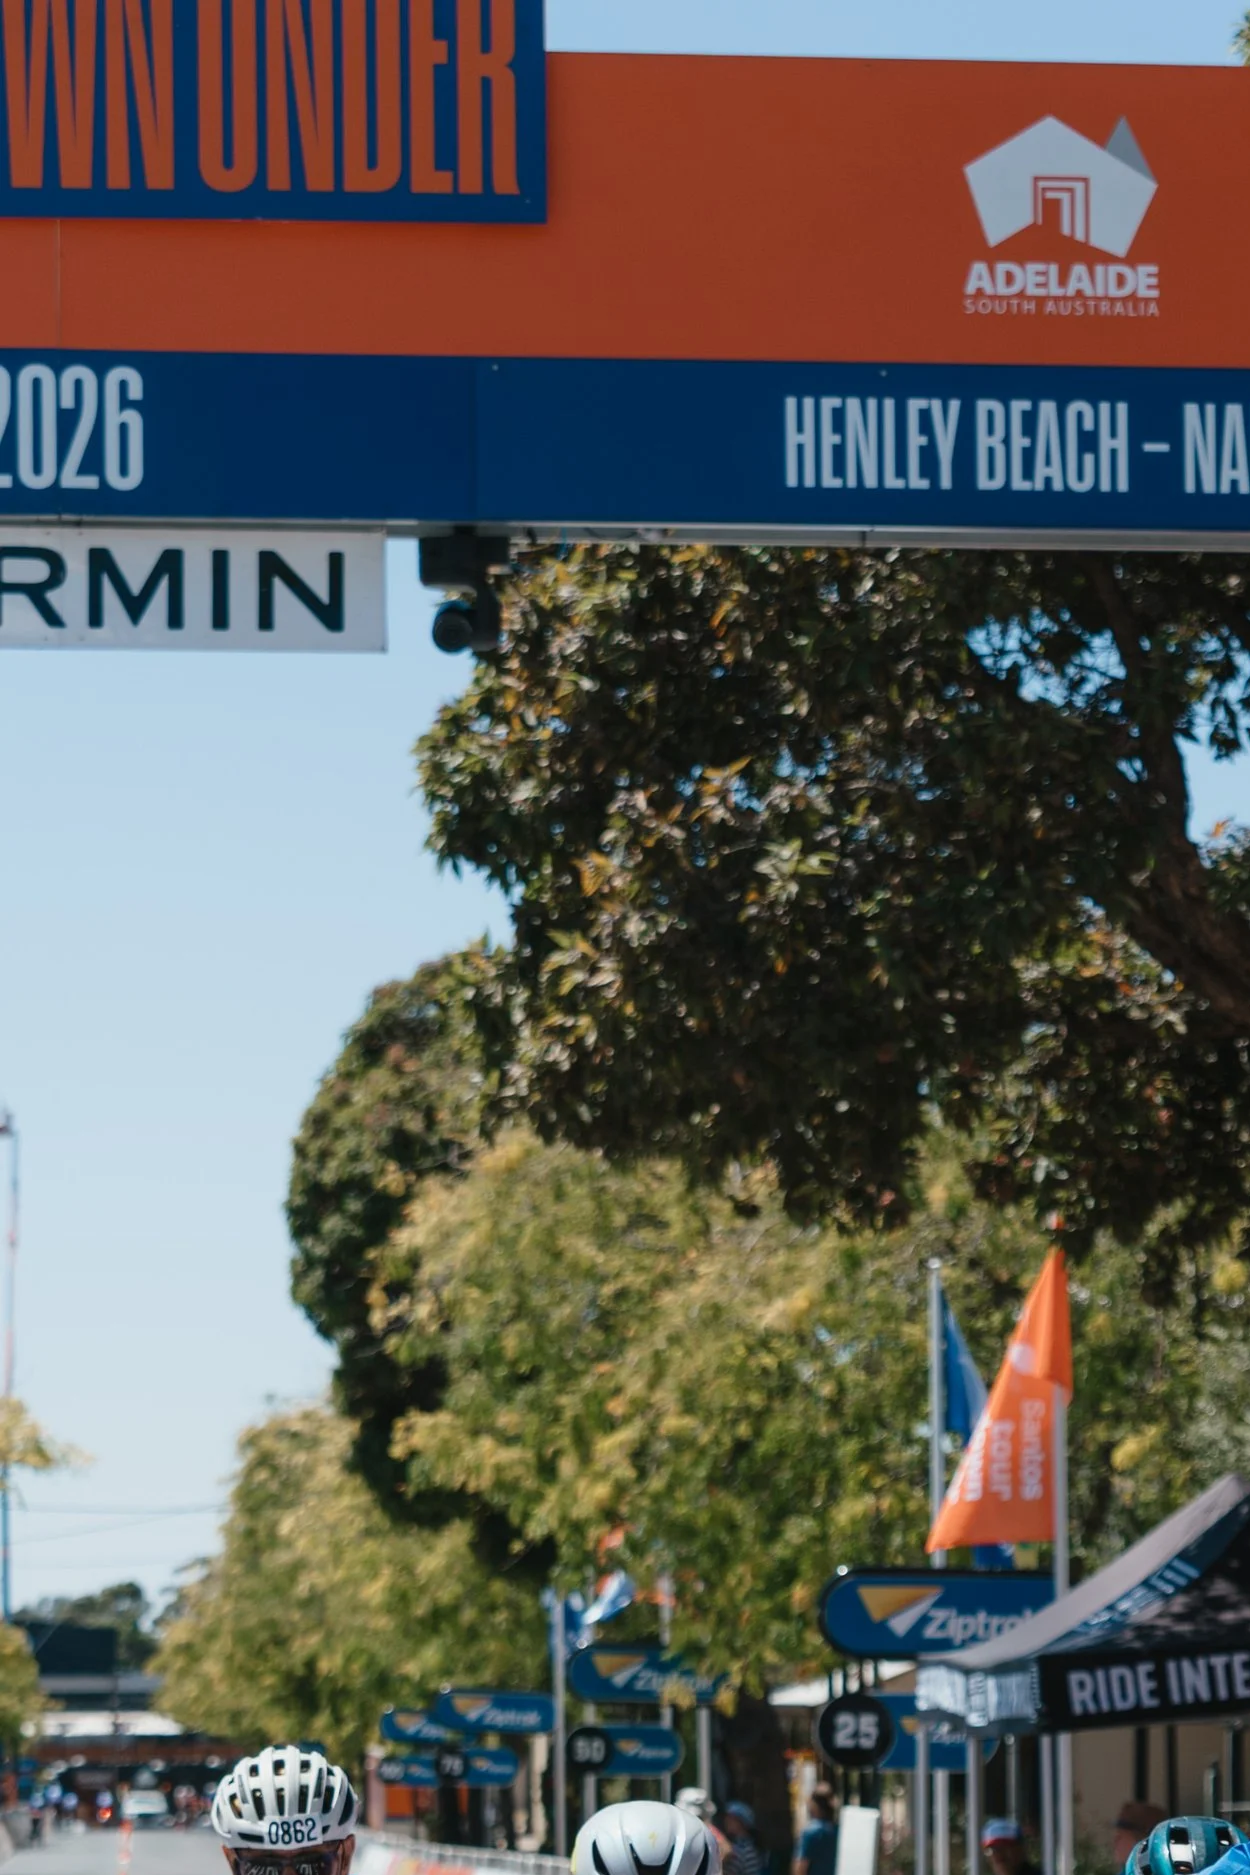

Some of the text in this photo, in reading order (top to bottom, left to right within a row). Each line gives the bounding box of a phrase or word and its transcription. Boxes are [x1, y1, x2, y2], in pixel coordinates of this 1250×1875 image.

[200, 0, 522, 195] UNDER
[964, 261, 1160, 299] ADELAIDE
[964, 299, 1160, 317] SOUTH AUSTRALIA
[0, 363, 144, 492] 026
[783, 396, 961, 491] HENLEY
[975, 399, 1130, 494] BEACH
[1067, 1661, 1161, 1716] RIDE
[833, 1711, 879, 1749] 25
[268, 1817, 318, 1846] 0862
